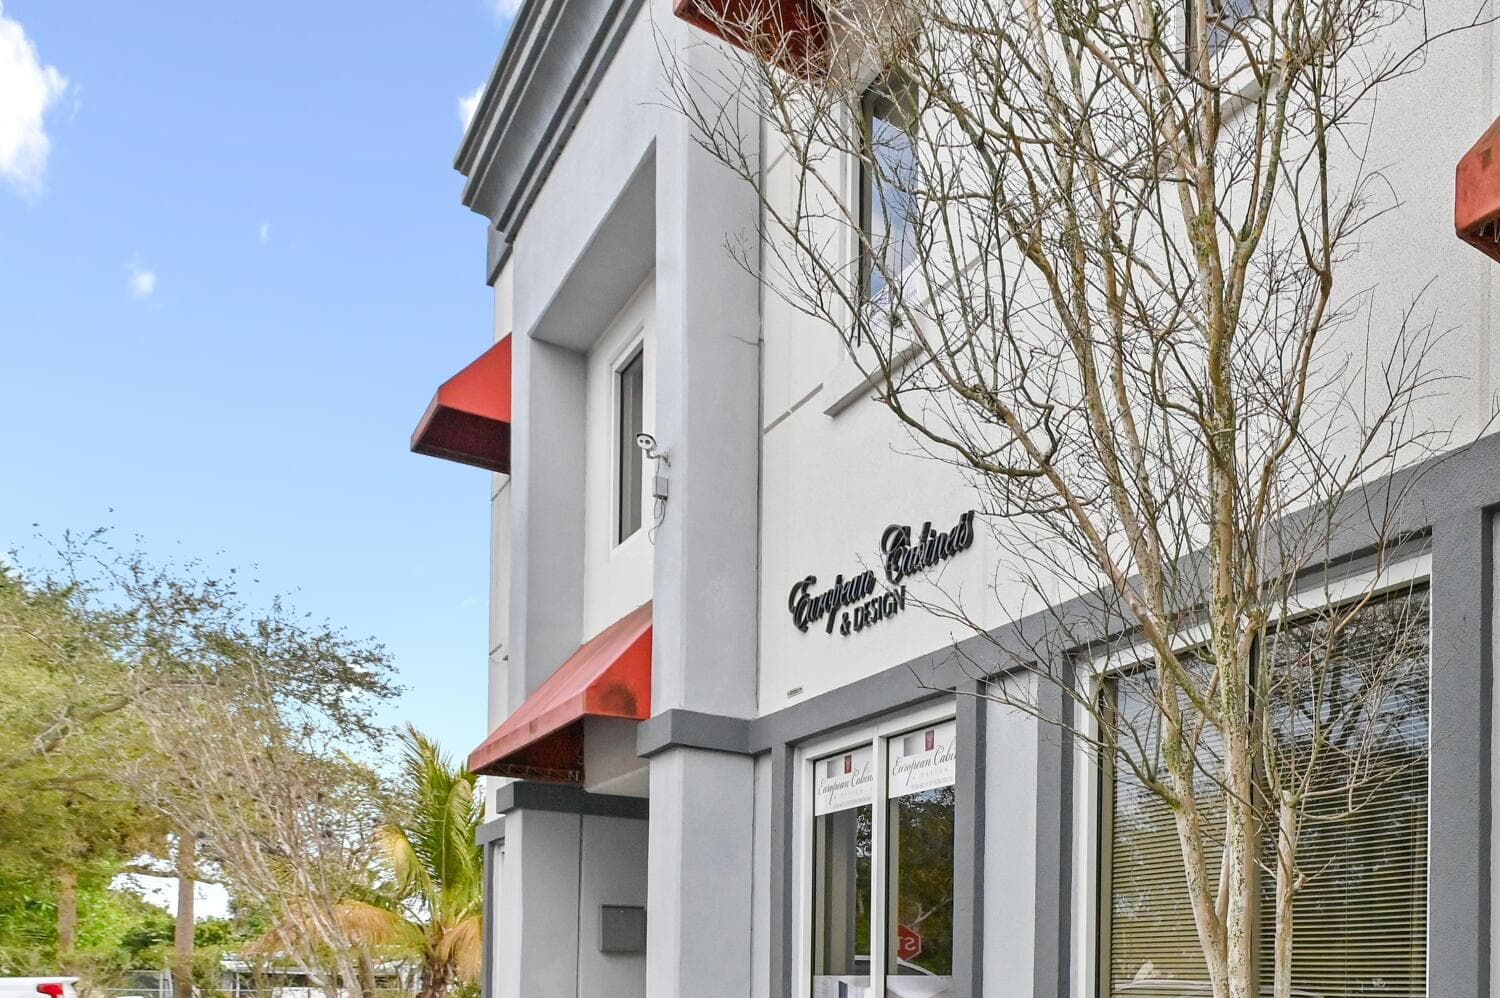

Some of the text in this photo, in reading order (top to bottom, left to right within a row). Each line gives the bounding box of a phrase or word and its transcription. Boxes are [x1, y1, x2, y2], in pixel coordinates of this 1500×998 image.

[788, 510, 975, 634] European Cabinets
[840, 585, 905, 636] & DESIGN
[892, 756, 931, 786] European
